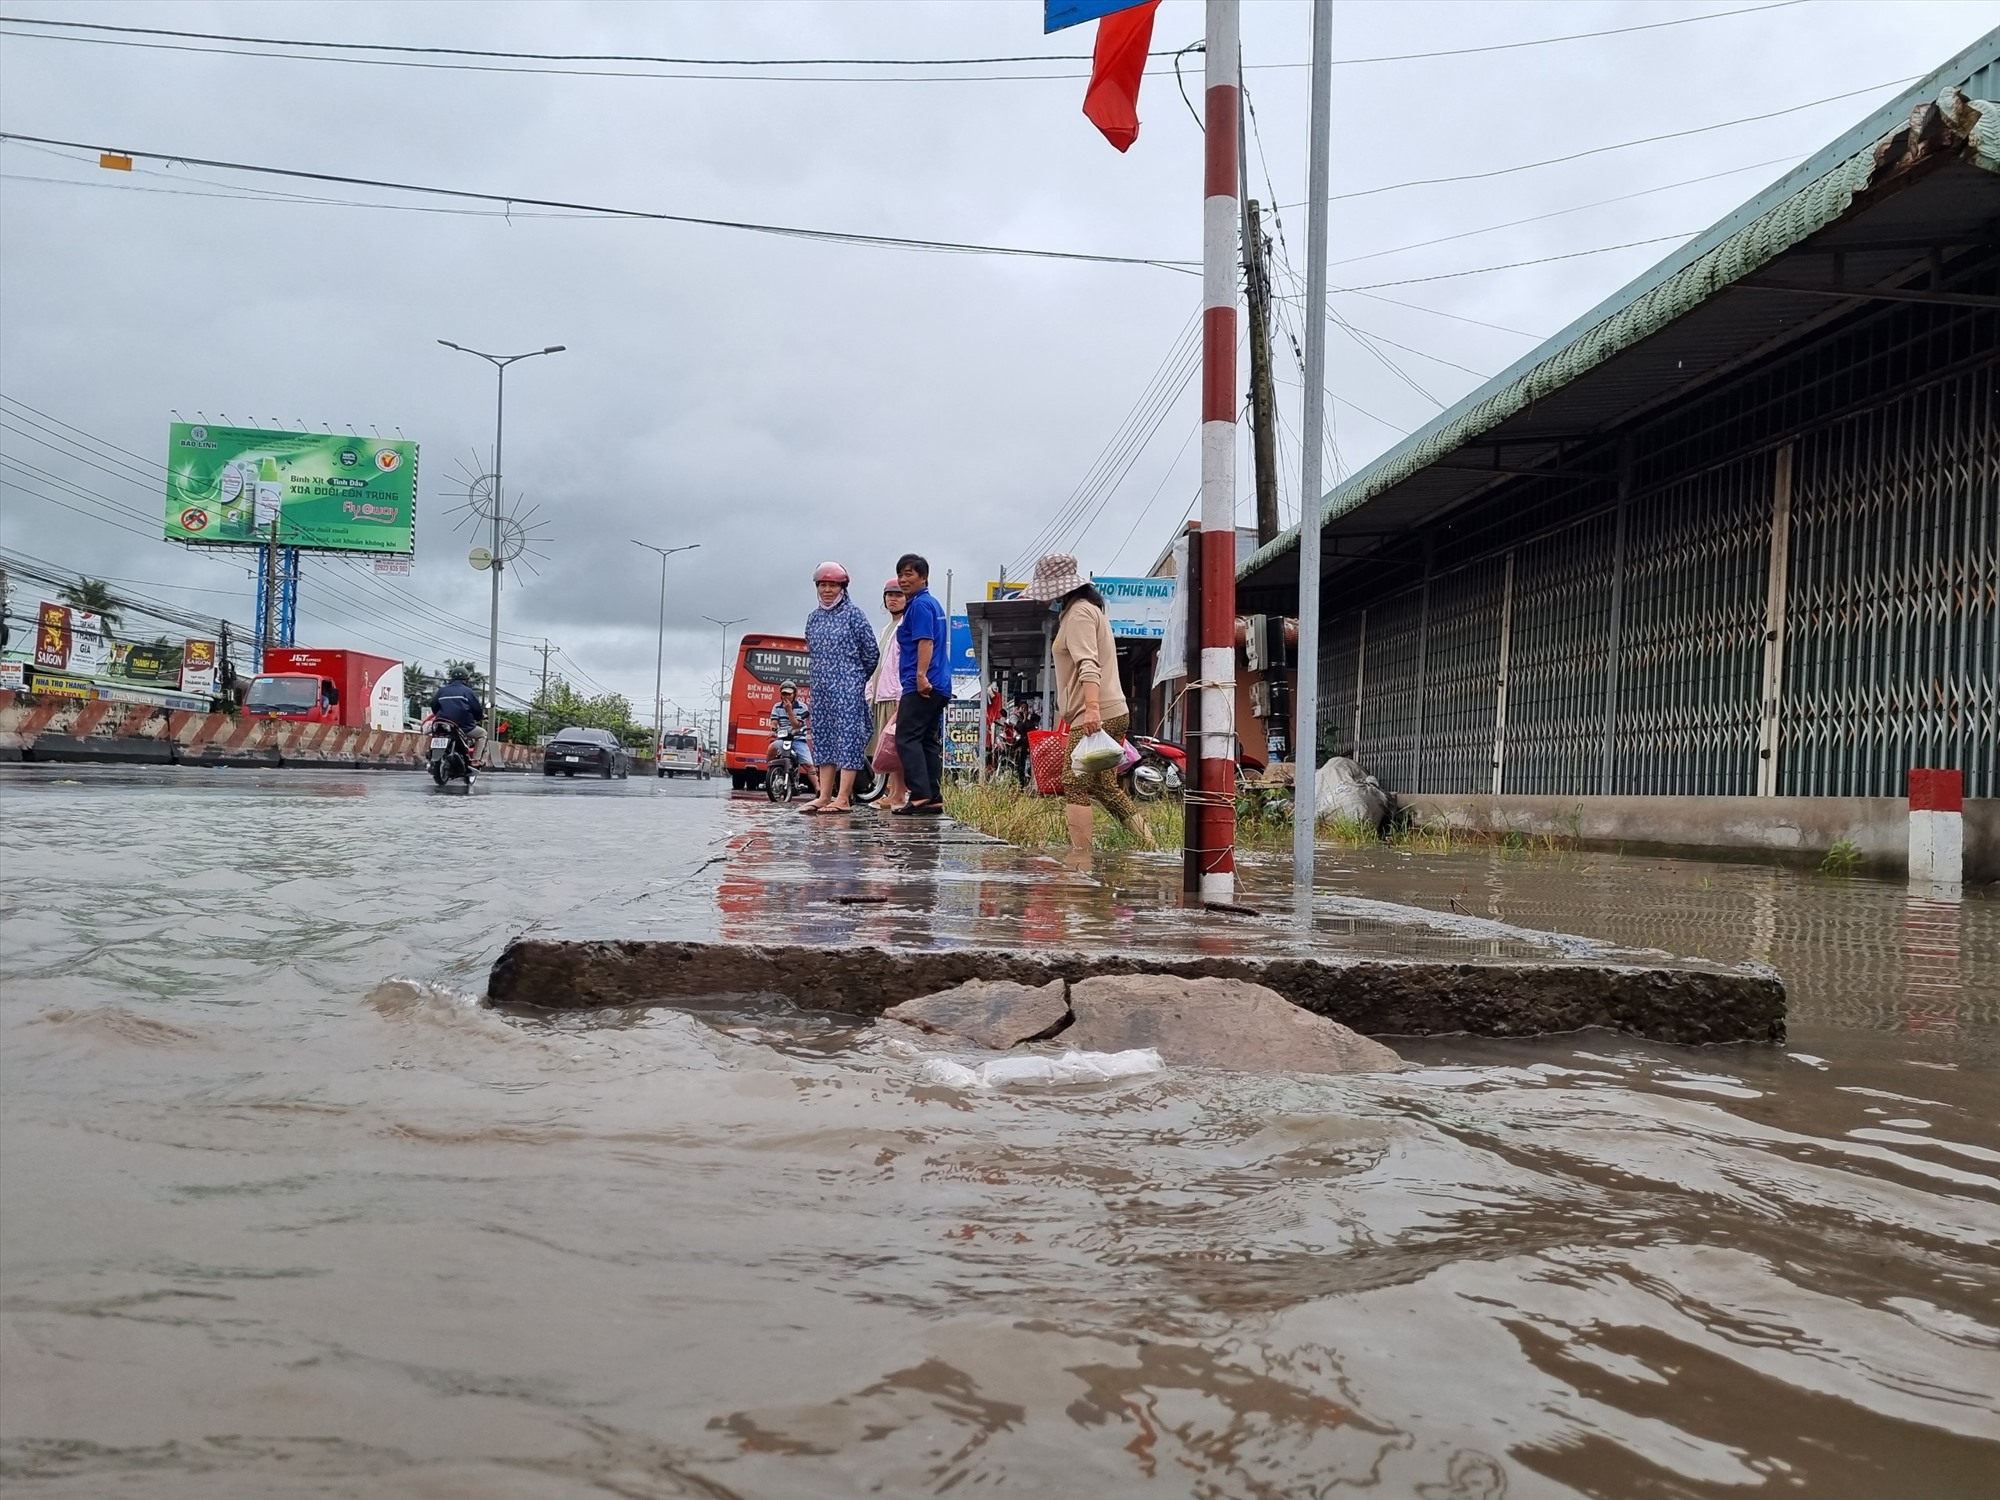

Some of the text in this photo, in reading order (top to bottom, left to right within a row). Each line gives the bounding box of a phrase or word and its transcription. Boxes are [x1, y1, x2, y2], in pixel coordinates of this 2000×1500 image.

[198, 441, 217, 449] LINH
[290, 474, 310, 483] Bình
[312, 476, 324, 485] Xịt
[1117, 580, 1144, 597] THUÊ
[1120, 626, 1147, 636] THUÊ
[80, 644, 91, 654] GIA
[37, 651, 63, 666] SAIGON
[289, 654, 310, 662] J&T
[755, 653, 780, 665] THU
[379, 686, 392, 700] J&T
[747, 684, 775, 693] BIÊN HÒA
[747, 691, 760, 699] CẦN
[948, 703, 980, 722] Game
